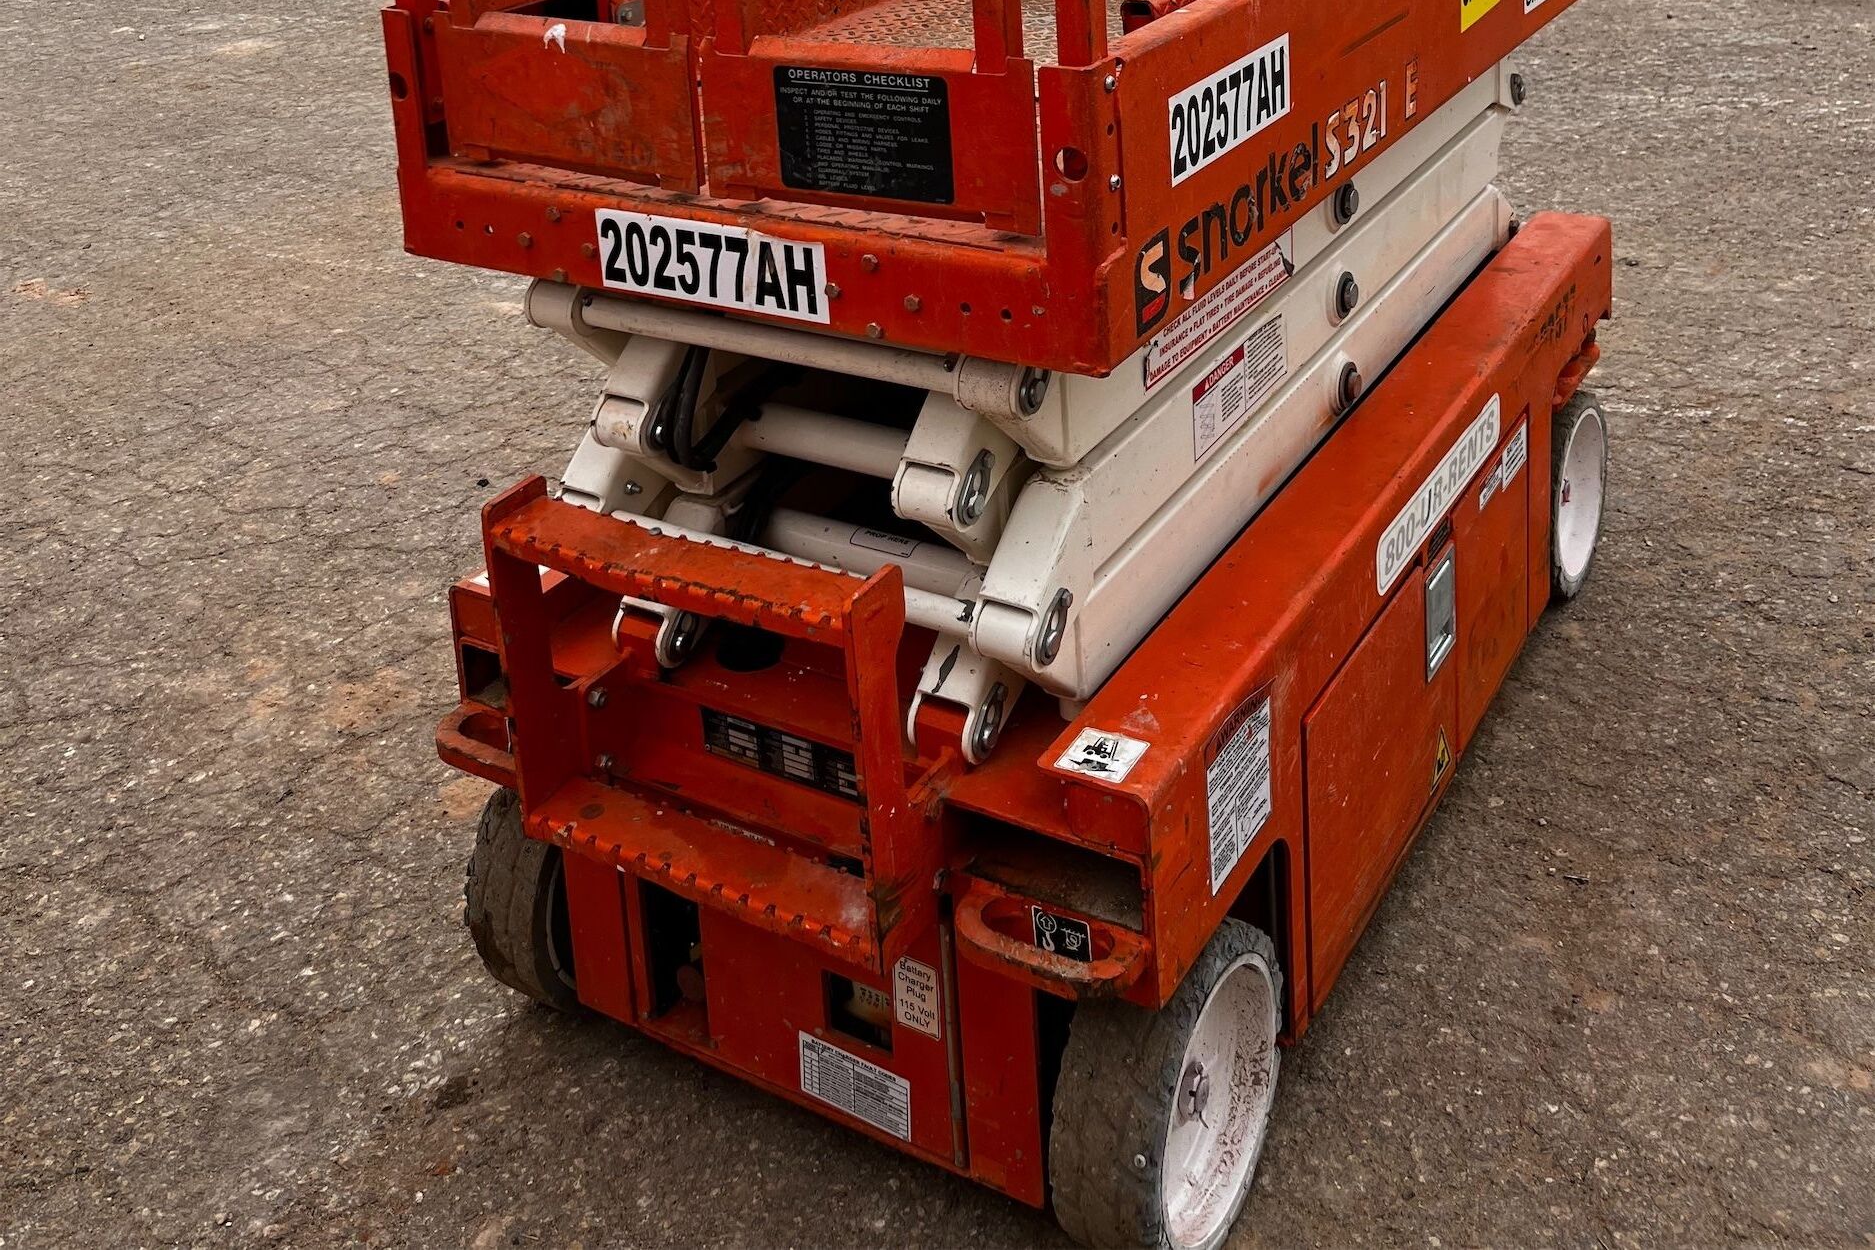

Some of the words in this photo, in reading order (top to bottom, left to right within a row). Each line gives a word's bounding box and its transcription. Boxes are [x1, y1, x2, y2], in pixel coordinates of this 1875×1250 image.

[787, 68, 857, 83] OPERATORS
[863, 73, 931, 88] CHECKLIST
[779, 86, 808, 96] INSPECT
[810, 88, 838, 97] AND/OR
[840, 91, 858, 99] TEST
[860, 92, 875, 100] THE
[877, 94, 919, 104] FOLLOWING
[921, 97, 942, 106] DAILY
[792, 95, 804, 104] OR
[805, 97, 814, 105] AT
[816, 98, 831, 106] THE
[832, 99, 871, 109] BEGINNING
[873, 102, 884, 110] OF
[886, 103, 907, 111] EACH
[1171, 45, 1286, 179] 202577AH
[1178, 122, 1319, 298] snorkel
[600, 217, 819, 316] 202577AH
[1162, 315, 1182, 338] CHECK
[1181, 310, 1192, 326] ALL
[1207, 286, 1226, 308] LEVELS
[1225, 275, 1240, 295] DAILY
[1239, 260, 1257, 281] BEFORE
[1193, 313, 1206, 330] FLAT
[1206, 303, 1221, 325] TIRES
[1224, 291, 1236, 309] TIRE
[1235, 278, 1255, 303] DAMAGE
[1257, 256, 1282, 282] REFUELING
[1149, 357, 1171, 382] DAMAGE
[1171, 351, 1180, 365] TO
[1179, 328, 1210, 361] EQUIPMENT
[1212, 310, 1234, 333] BATTERY
[1233, 285, 1266, 316] MAINTENANCE
[1208, 355, 1235, 387] DANGER
[1383, 408, 1496, 577] 800-UR-RENTS
[864, 530, 887, 539] PROP
[887, 535, 910, 545] HERE
[898, 971, 935, 993] Charger
[899, 960, 931, 982] Battery
[906, 985, 927, 1003] Plug
[899, 998, 915, 1011] 115
[917, 1005, 936, 1020] Volt
[904, 1011, 931, 1029] ONLY
